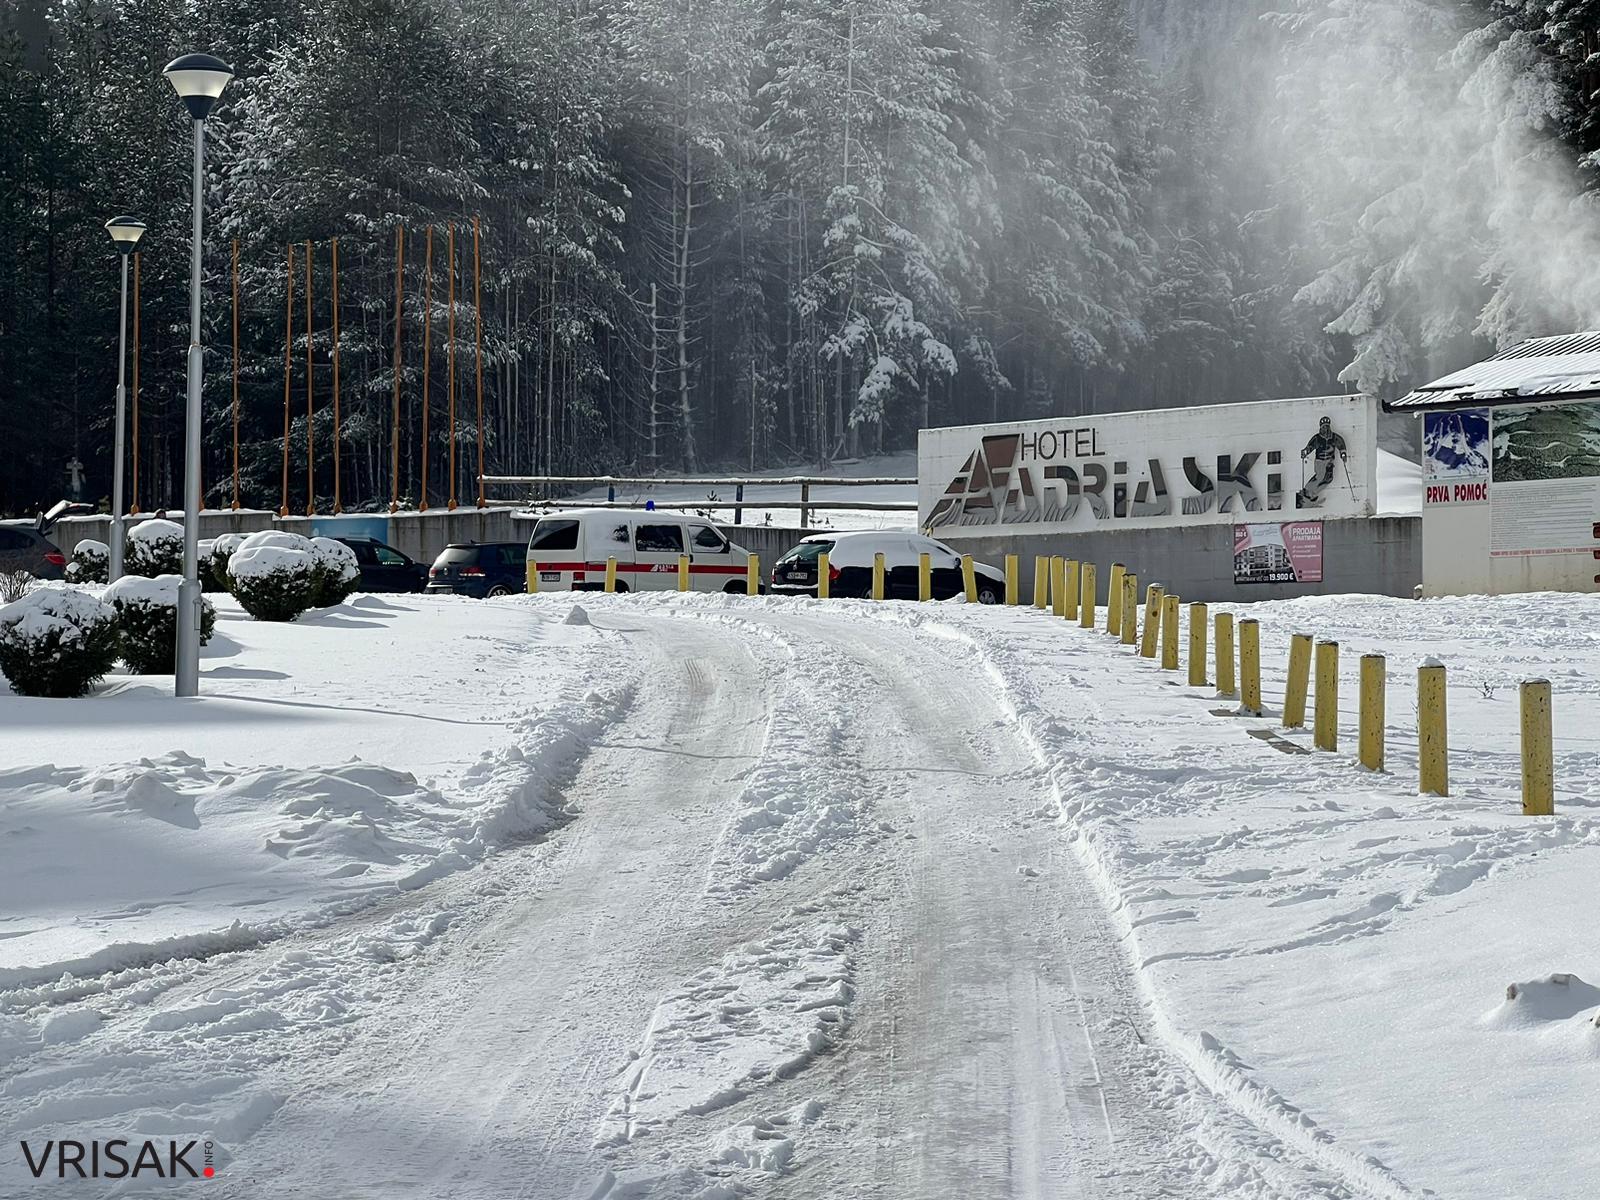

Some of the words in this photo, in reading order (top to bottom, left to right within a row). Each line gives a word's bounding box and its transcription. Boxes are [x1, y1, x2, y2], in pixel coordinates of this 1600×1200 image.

[1021, 428, 1105, 461] HOTEL
[1427, 485, 1450, 503] PRVA
[1454, 479, 1487, 502] POMOĆ
[1292, 526, 1321, 536] PRODAJA
